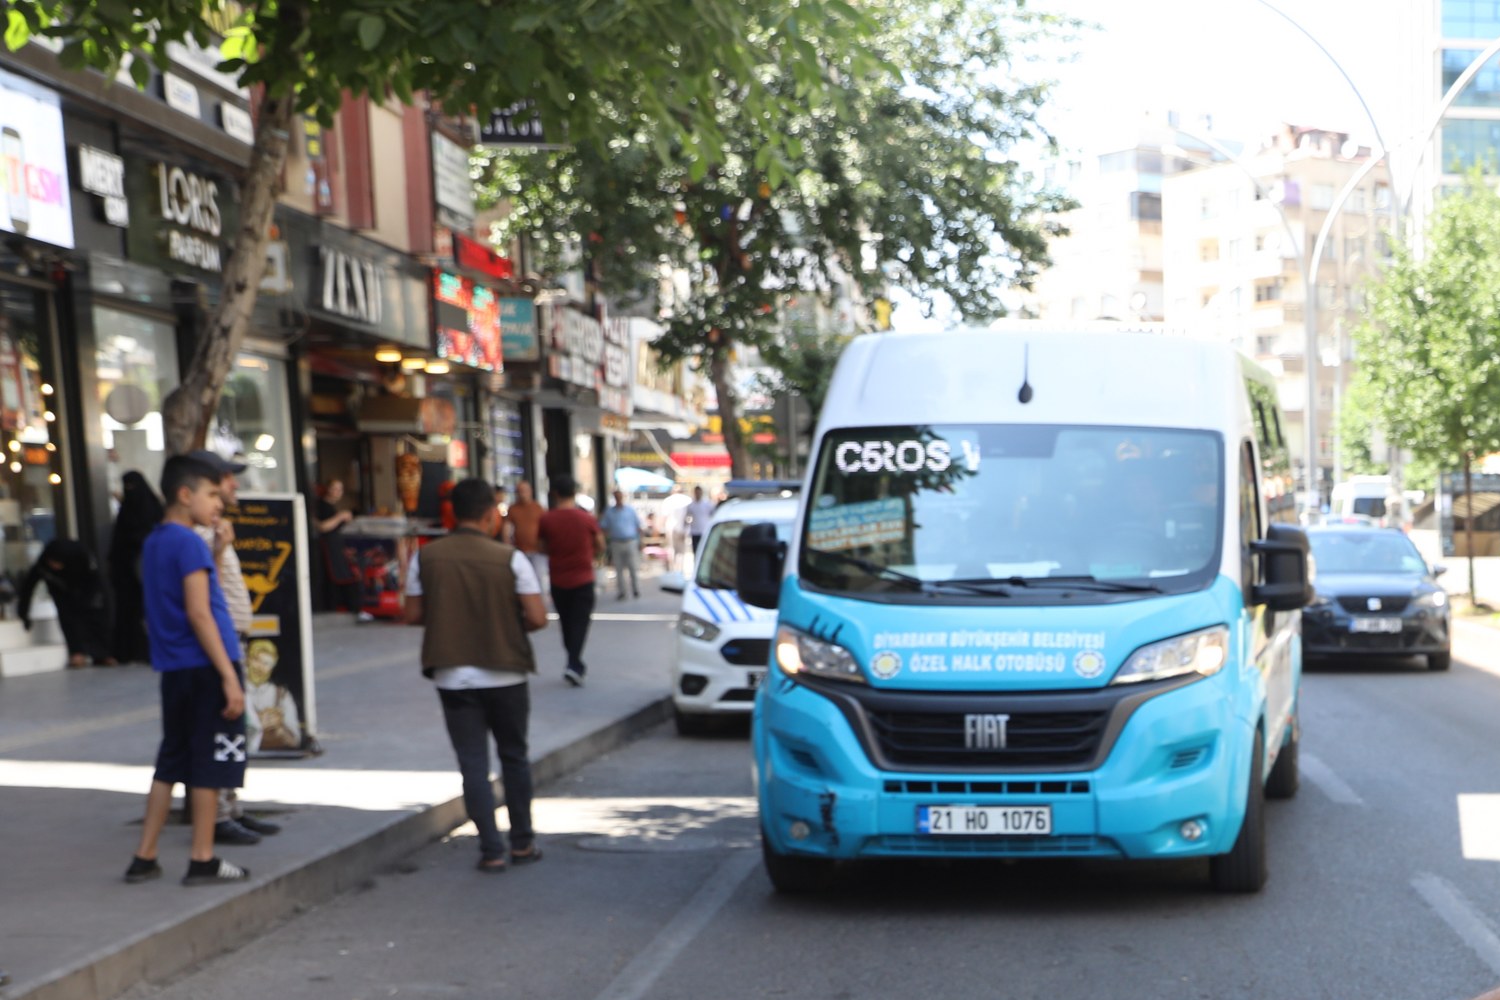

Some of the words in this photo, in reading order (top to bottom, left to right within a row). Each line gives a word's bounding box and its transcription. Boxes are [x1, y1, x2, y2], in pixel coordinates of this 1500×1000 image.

[158, 161, 222, 237] LORIS
[873, 631, 948, 650] DİYARBAKIR
[950, 630, 1030, 652] BÜYÜKŞEHİR
[1032, 631, 1106, 650] BELEDİYESİ
[909, 652, 948, 672] ÖZEL
[952, 654, 992, 672] HALK
[995, 652, 1066, 672] OTOBÜSÜ
[964, 714, 1011, 749] FIAT
[932, 810, 953, 830] 21
[1002, 810, 1046, 830] 1076
